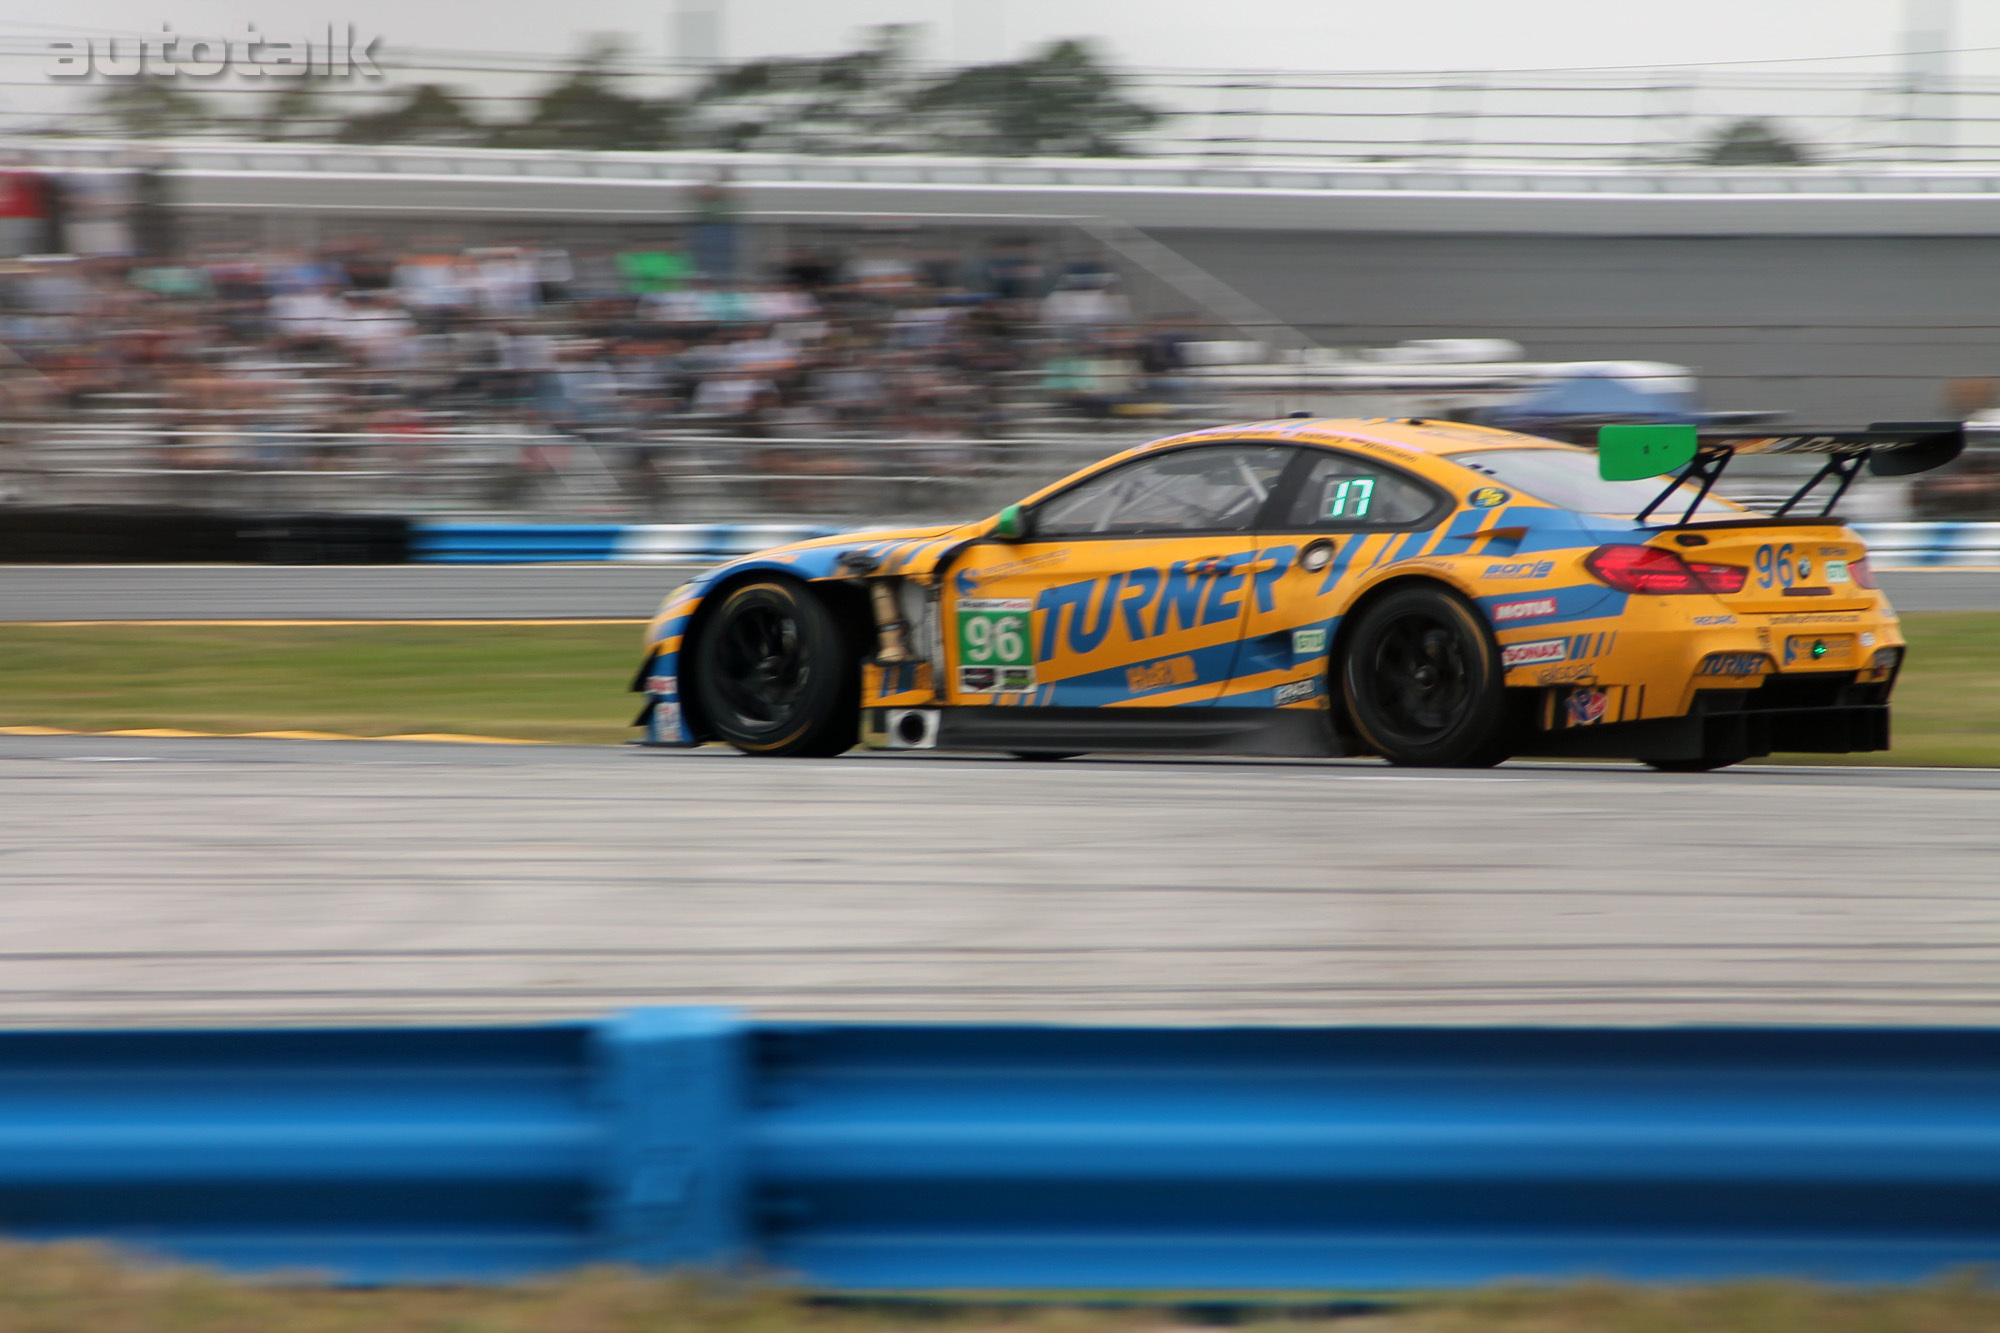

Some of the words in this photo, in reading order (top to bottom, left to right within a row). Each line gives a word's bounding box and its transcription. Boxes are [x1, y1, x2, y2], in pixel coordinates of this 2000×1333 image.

[1332, 479, 1375, 516] 17
[1755, 543, 1794, 588] 96
[1034, 545, 1299, 662] TURNER
[1495, 599, 1555, 620] MOTUL
[965, 616, 1024, 662] 96
[1504, 643, 1562, 662] SONAX
[1701, 654, 1767, 676] TURNER
